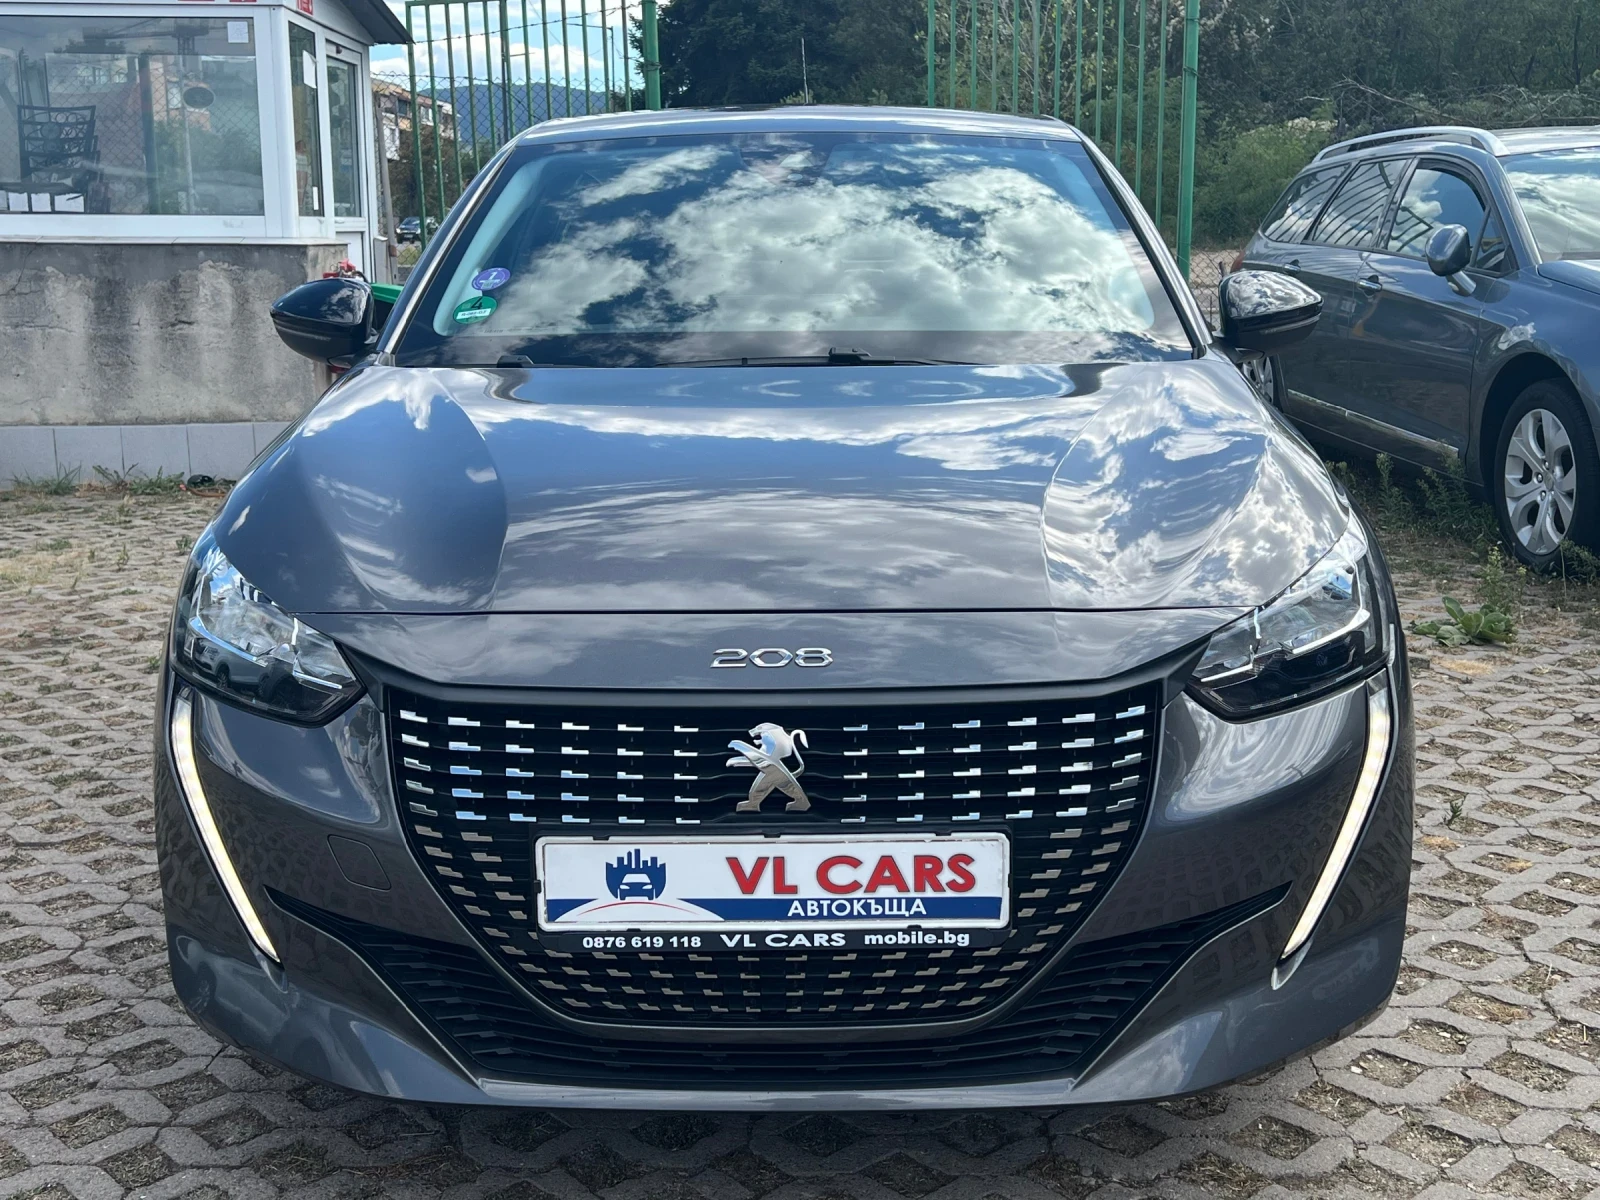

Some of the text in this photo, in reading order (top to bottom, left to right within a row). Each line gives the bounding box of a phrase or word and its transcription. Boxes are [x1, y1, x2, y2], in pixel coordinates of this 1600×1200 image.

[471, 297, 483, 309] 4
[710, 647, 834, 668] 208
[725, 853, 976, 894] VL CARS
[787, 899, 927, 917] АВТОКЪЩА
[582, 931, 970, 948] 0876 619 118 VL CARS mobile.bg
